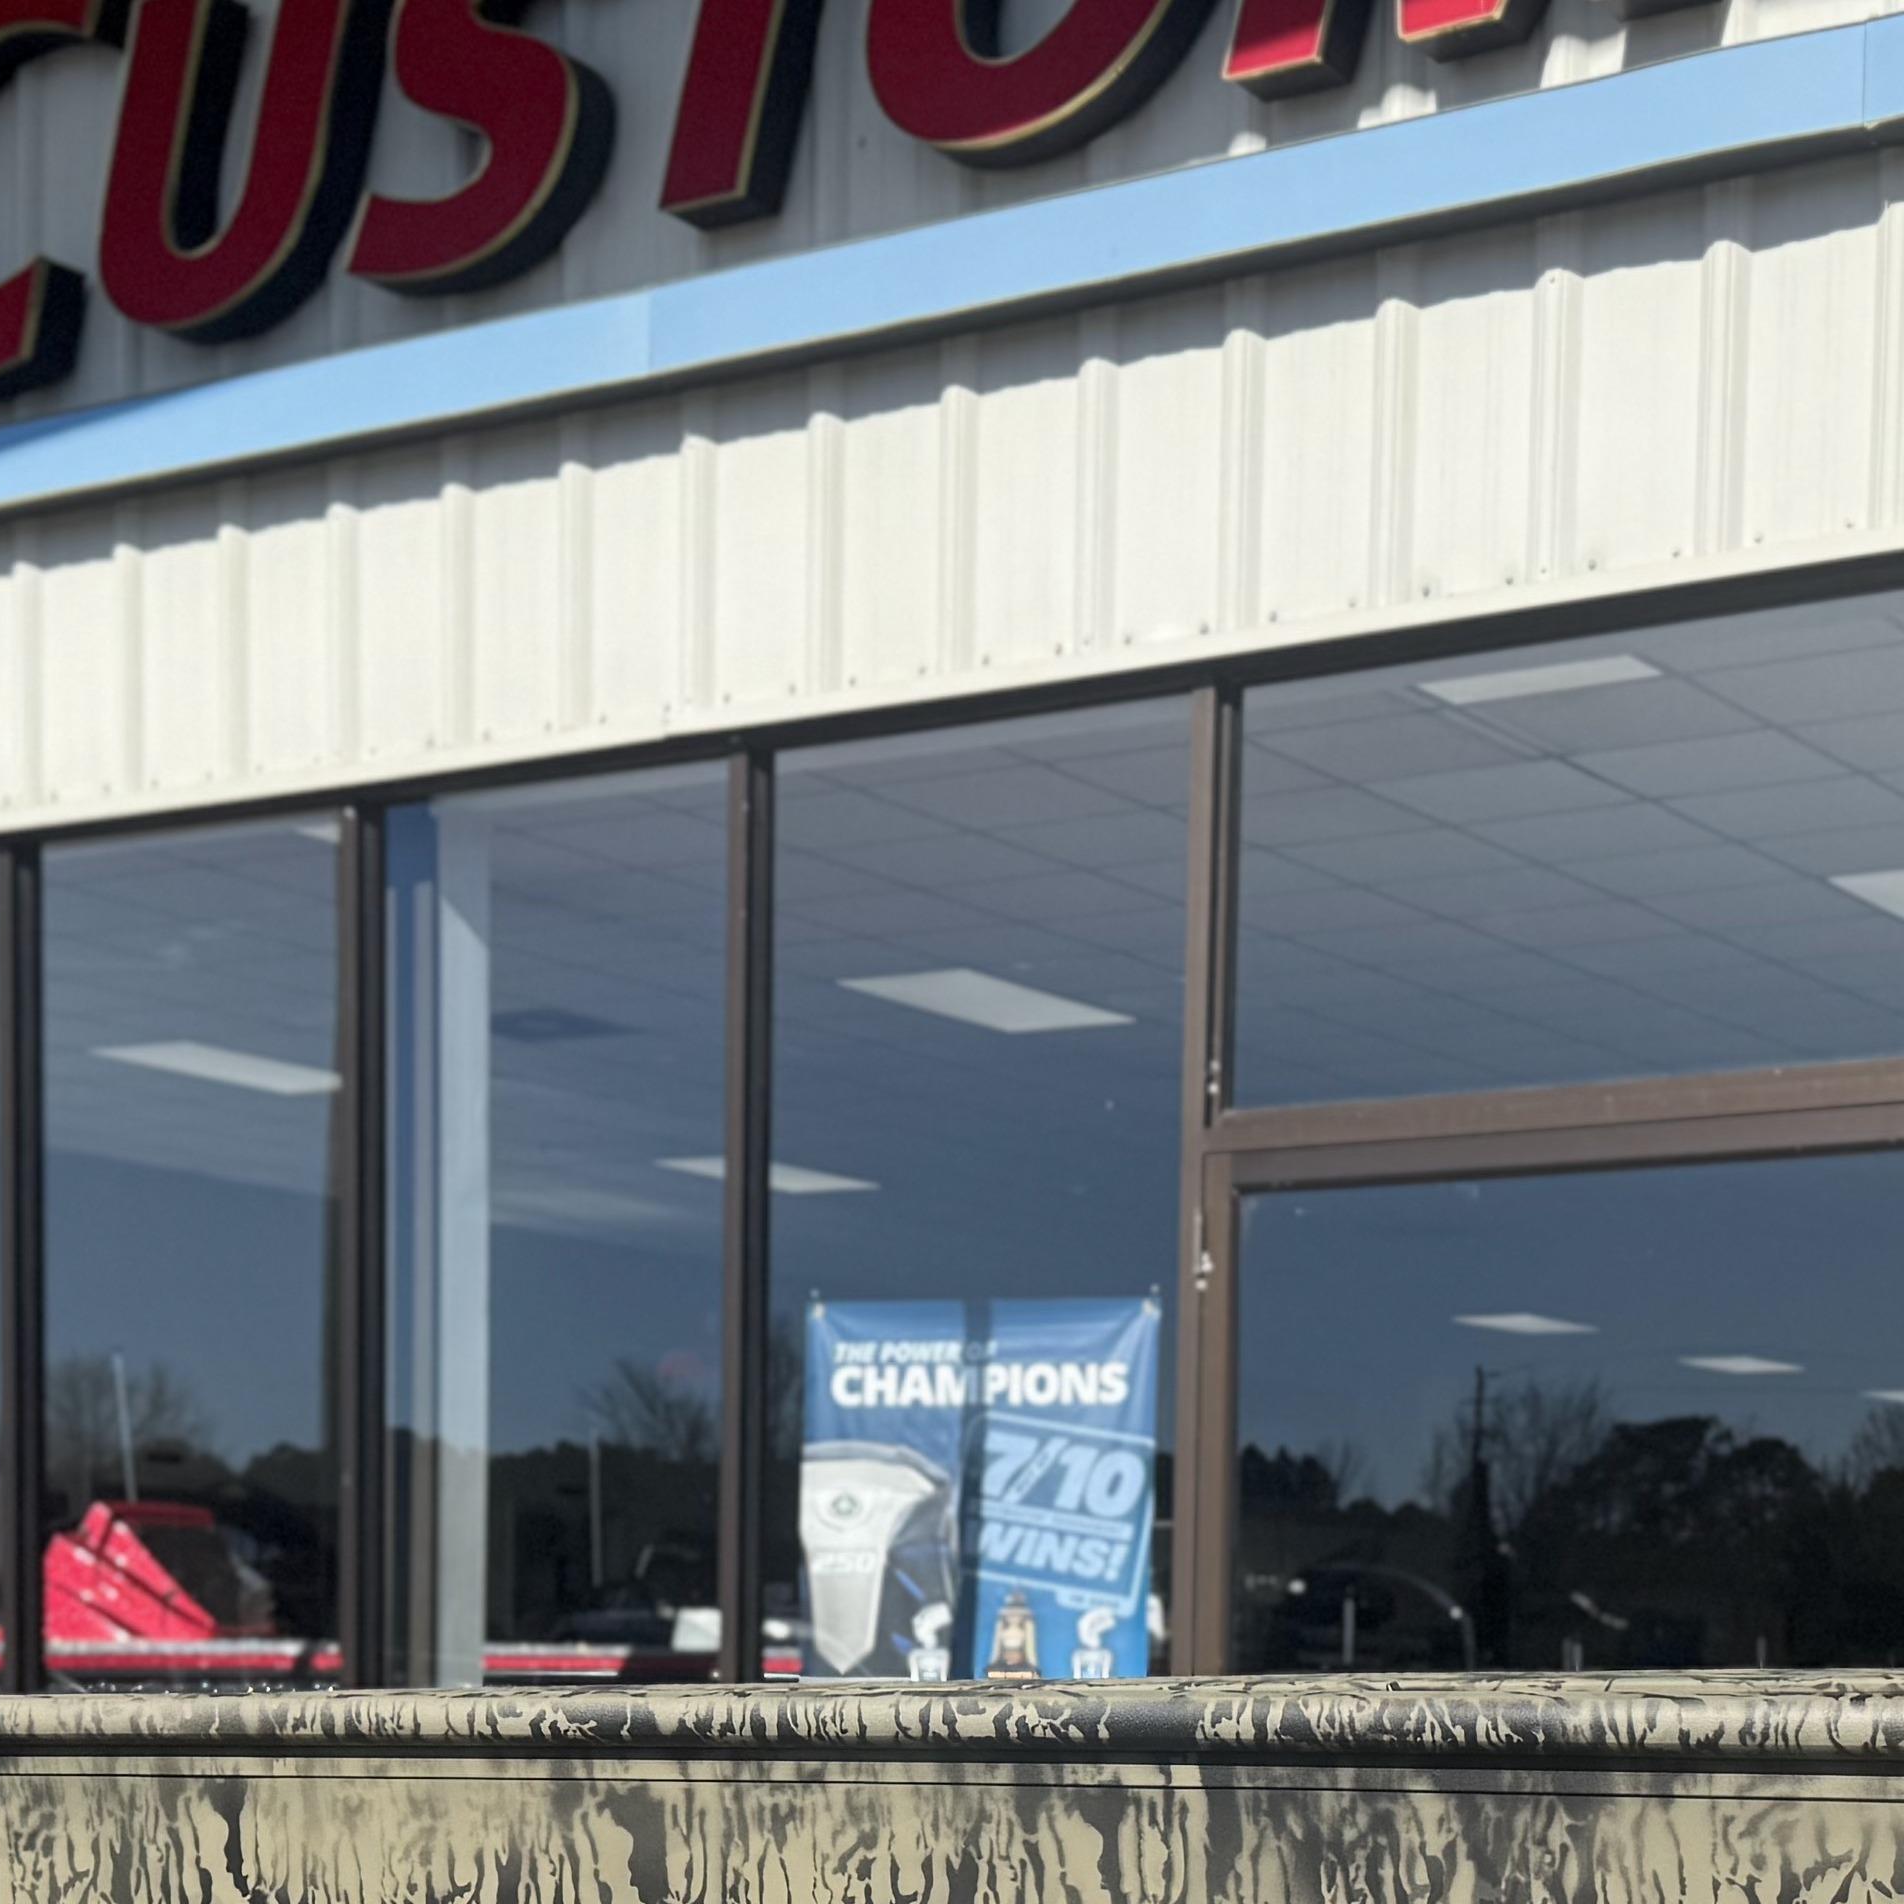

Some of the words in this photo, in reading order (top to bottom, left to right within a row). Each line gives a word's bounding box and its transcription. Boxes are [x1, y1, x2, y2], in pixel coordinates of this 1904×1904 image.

[836, 1342, 874, 1363] THE
[881, 1341, 963, 1363] POWER
[831, 1363, 1129, 1407] CHAMPIONS
[985, 1432, 1146, 1517] 7/10
[811, 1552, 875, 1575] 250
[980, 1523, 1129, 1581] WINS!
